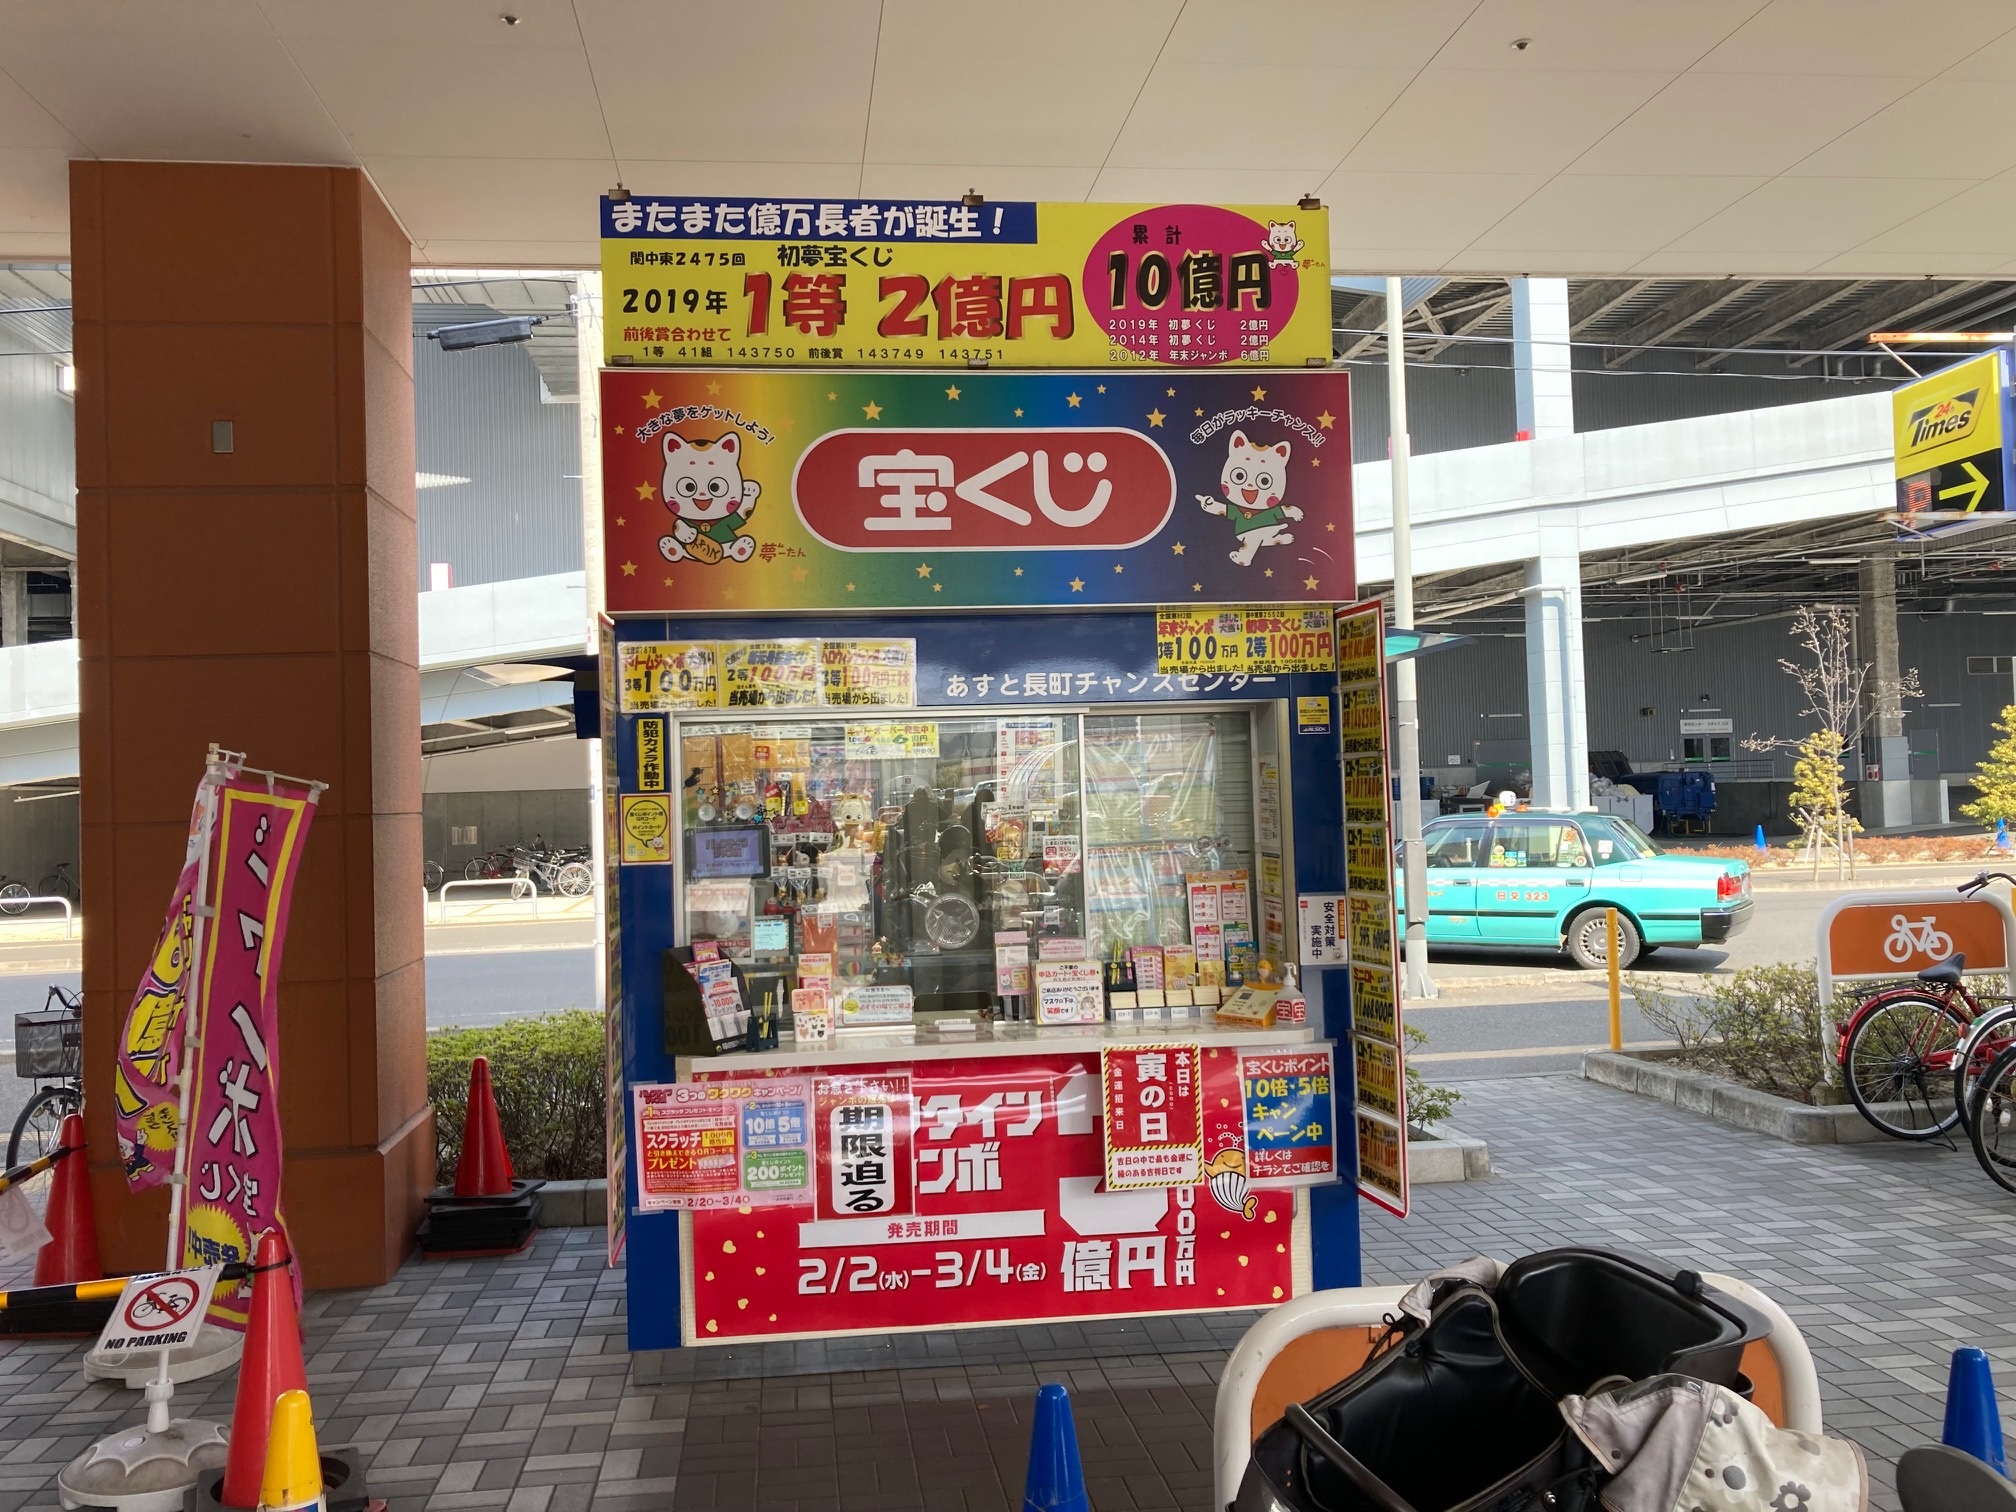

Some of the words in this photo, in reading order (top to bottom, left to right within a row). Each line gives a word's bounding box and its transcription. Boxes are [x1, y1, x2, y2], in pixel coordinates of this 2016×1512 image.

[611, 202, 1004, 239] またまた億万長者が誕生!
[630, 251, 746, 267] 関中東2475回
[777, 245, 893, 268] 初夢宝くじ
[1107, 250, 1273, 312] 10億円
[622, 288, 728, 315] 2019年
[743, 271, 847, 338] 1等
[877, 272, 1075, 341] 2億円
[623, 327, 731, 342] 前後賞合わせて
[1109, 319, 1158, 331] 2019年
[1168, 319, 1216, 331] 初夢くじ
[1240, 319, 1269, 332] 2億円
[1109, 334, 1158, 346] 2014年
[1168, 334, 1216, 346] 初夢くじ
[1240, 335, 1270, 347] 2億円
[642, 347, 664, 358] 1等
[678, 347, 713, 359] 41組
[727, 347, 795, 359] 143750
[808, 348, 843, 360] 前後賞
[857, 349, 925, 359] 143749
[939, 349, 1004, 360] 143751
[1109, 350, 1159, 362] 2012年
[1169, 350, 1228, 362] 年末ジャンボ
[1240, 350, 1270, 362] 6億円
[635, 405, 775, 446] 大きな夢をゲットしよう!
[1189, 405, 1327, 448] 毎日がラッキーチャンス!!
[1911, 409, 1972, 448] Times
[858, 449, 1113, 531] 宝くじ
[1246, 632, 1333, 659] 2等100万円
[1160, 664, 1244, 675] 当売場から出ました!
[1247, 663, 1335, 675] 当売場から出ました!
[946, 672, 1277, 699] あすと長町チャンスセンター
[643, 720, 662, 789] 防犯カメラ作動中
[1525, 891, 1549, 900] 323
[1323, 901, 1336, 947] 安全対策
[1311, 924, 1323, 959] 実施中
[1175, 1051, 1191, 1097] 本日は
[1246, 1056, 1330, 1076] 宝くじポイント
[1113, 1066, 1125, 1130] 金運招来日
[1135, 1052, 1169, 1143] 寅の日
[1252, 1102, 1297, 1121] キャン
[746, 1117, 776, 1134] 10倍
[778, 1115, 801, 1133] 5倍
[1256, 1122, 1323, 1142] ペーン中
[647, 1132, 701, 1149] スクラッチ
[648, 1158, 697, 1170] プレゼント
[839, 1106, 887, 1212] 期限迫る
[1117, 1153, 1193, 1166] 吉日の中で最も金運に
[1254, 1149, 1293, 1163] 詳しくは
[747, 1165, 779, 1181] 200
[914, 1141, 1002, 1194] ンボ
[1252, 1161, 1330, 1177] チラシでご確認を
[887, 1219, 959, 1239] 発売期間
[1060, 1236, 1168, 1292] 億円
[104, 1338, 125, 1350] NO
[126, 1331, 188, 1348] PARKING
